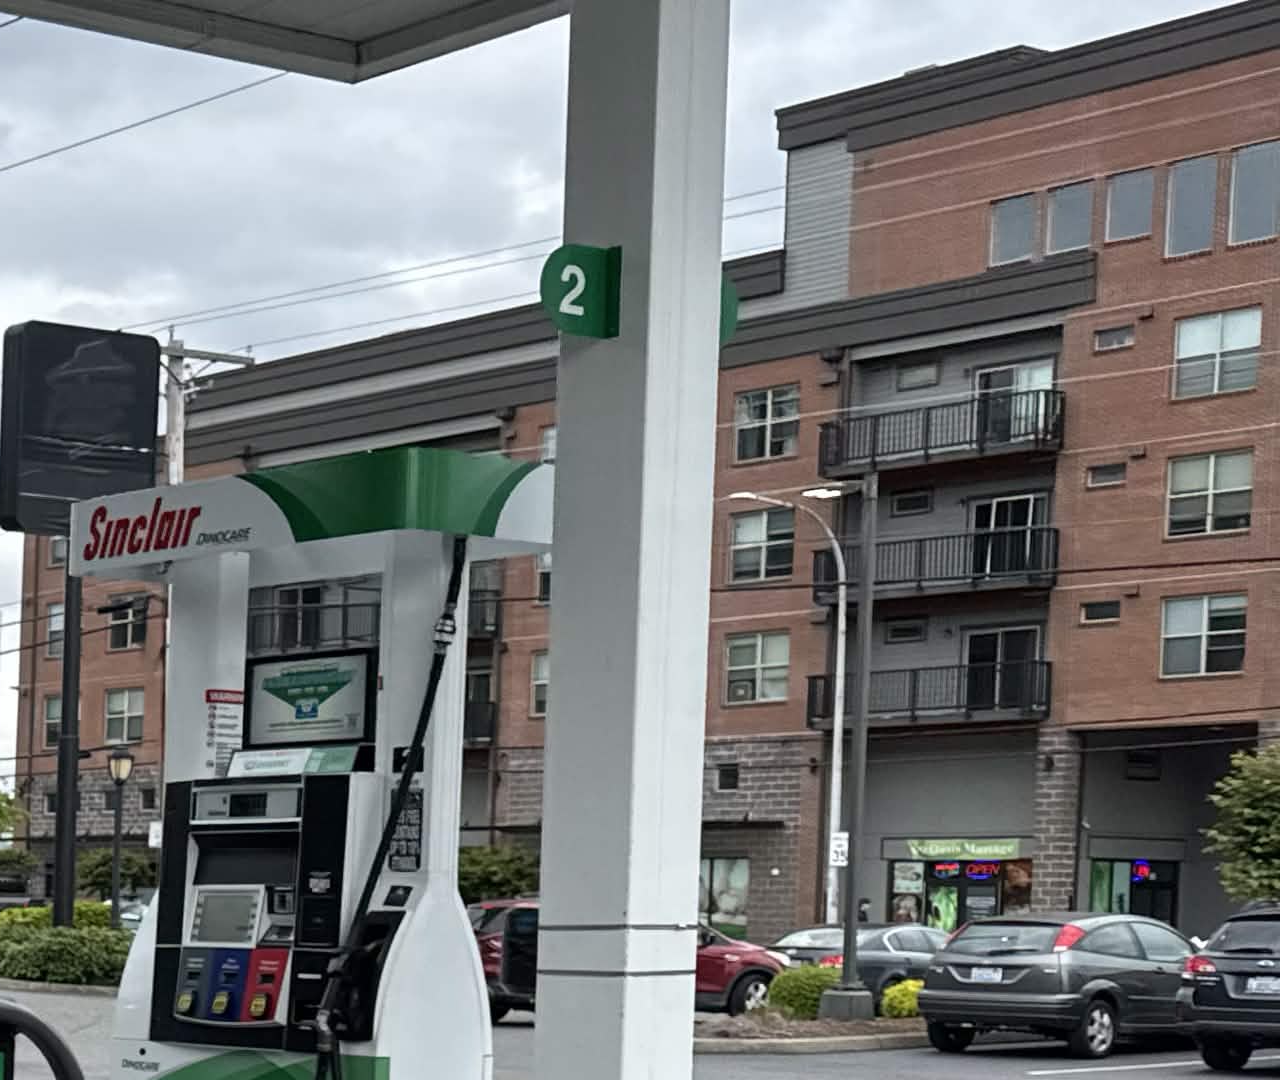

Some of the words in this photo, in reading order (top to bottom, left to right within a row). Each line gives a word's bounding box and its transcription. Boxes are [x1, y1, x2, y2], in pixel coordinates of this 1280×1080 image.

[559, 264, 586, 316] 2
[83, 496, 202, 561] Sinclair
[966, 863, 1000, 876] OPEN
